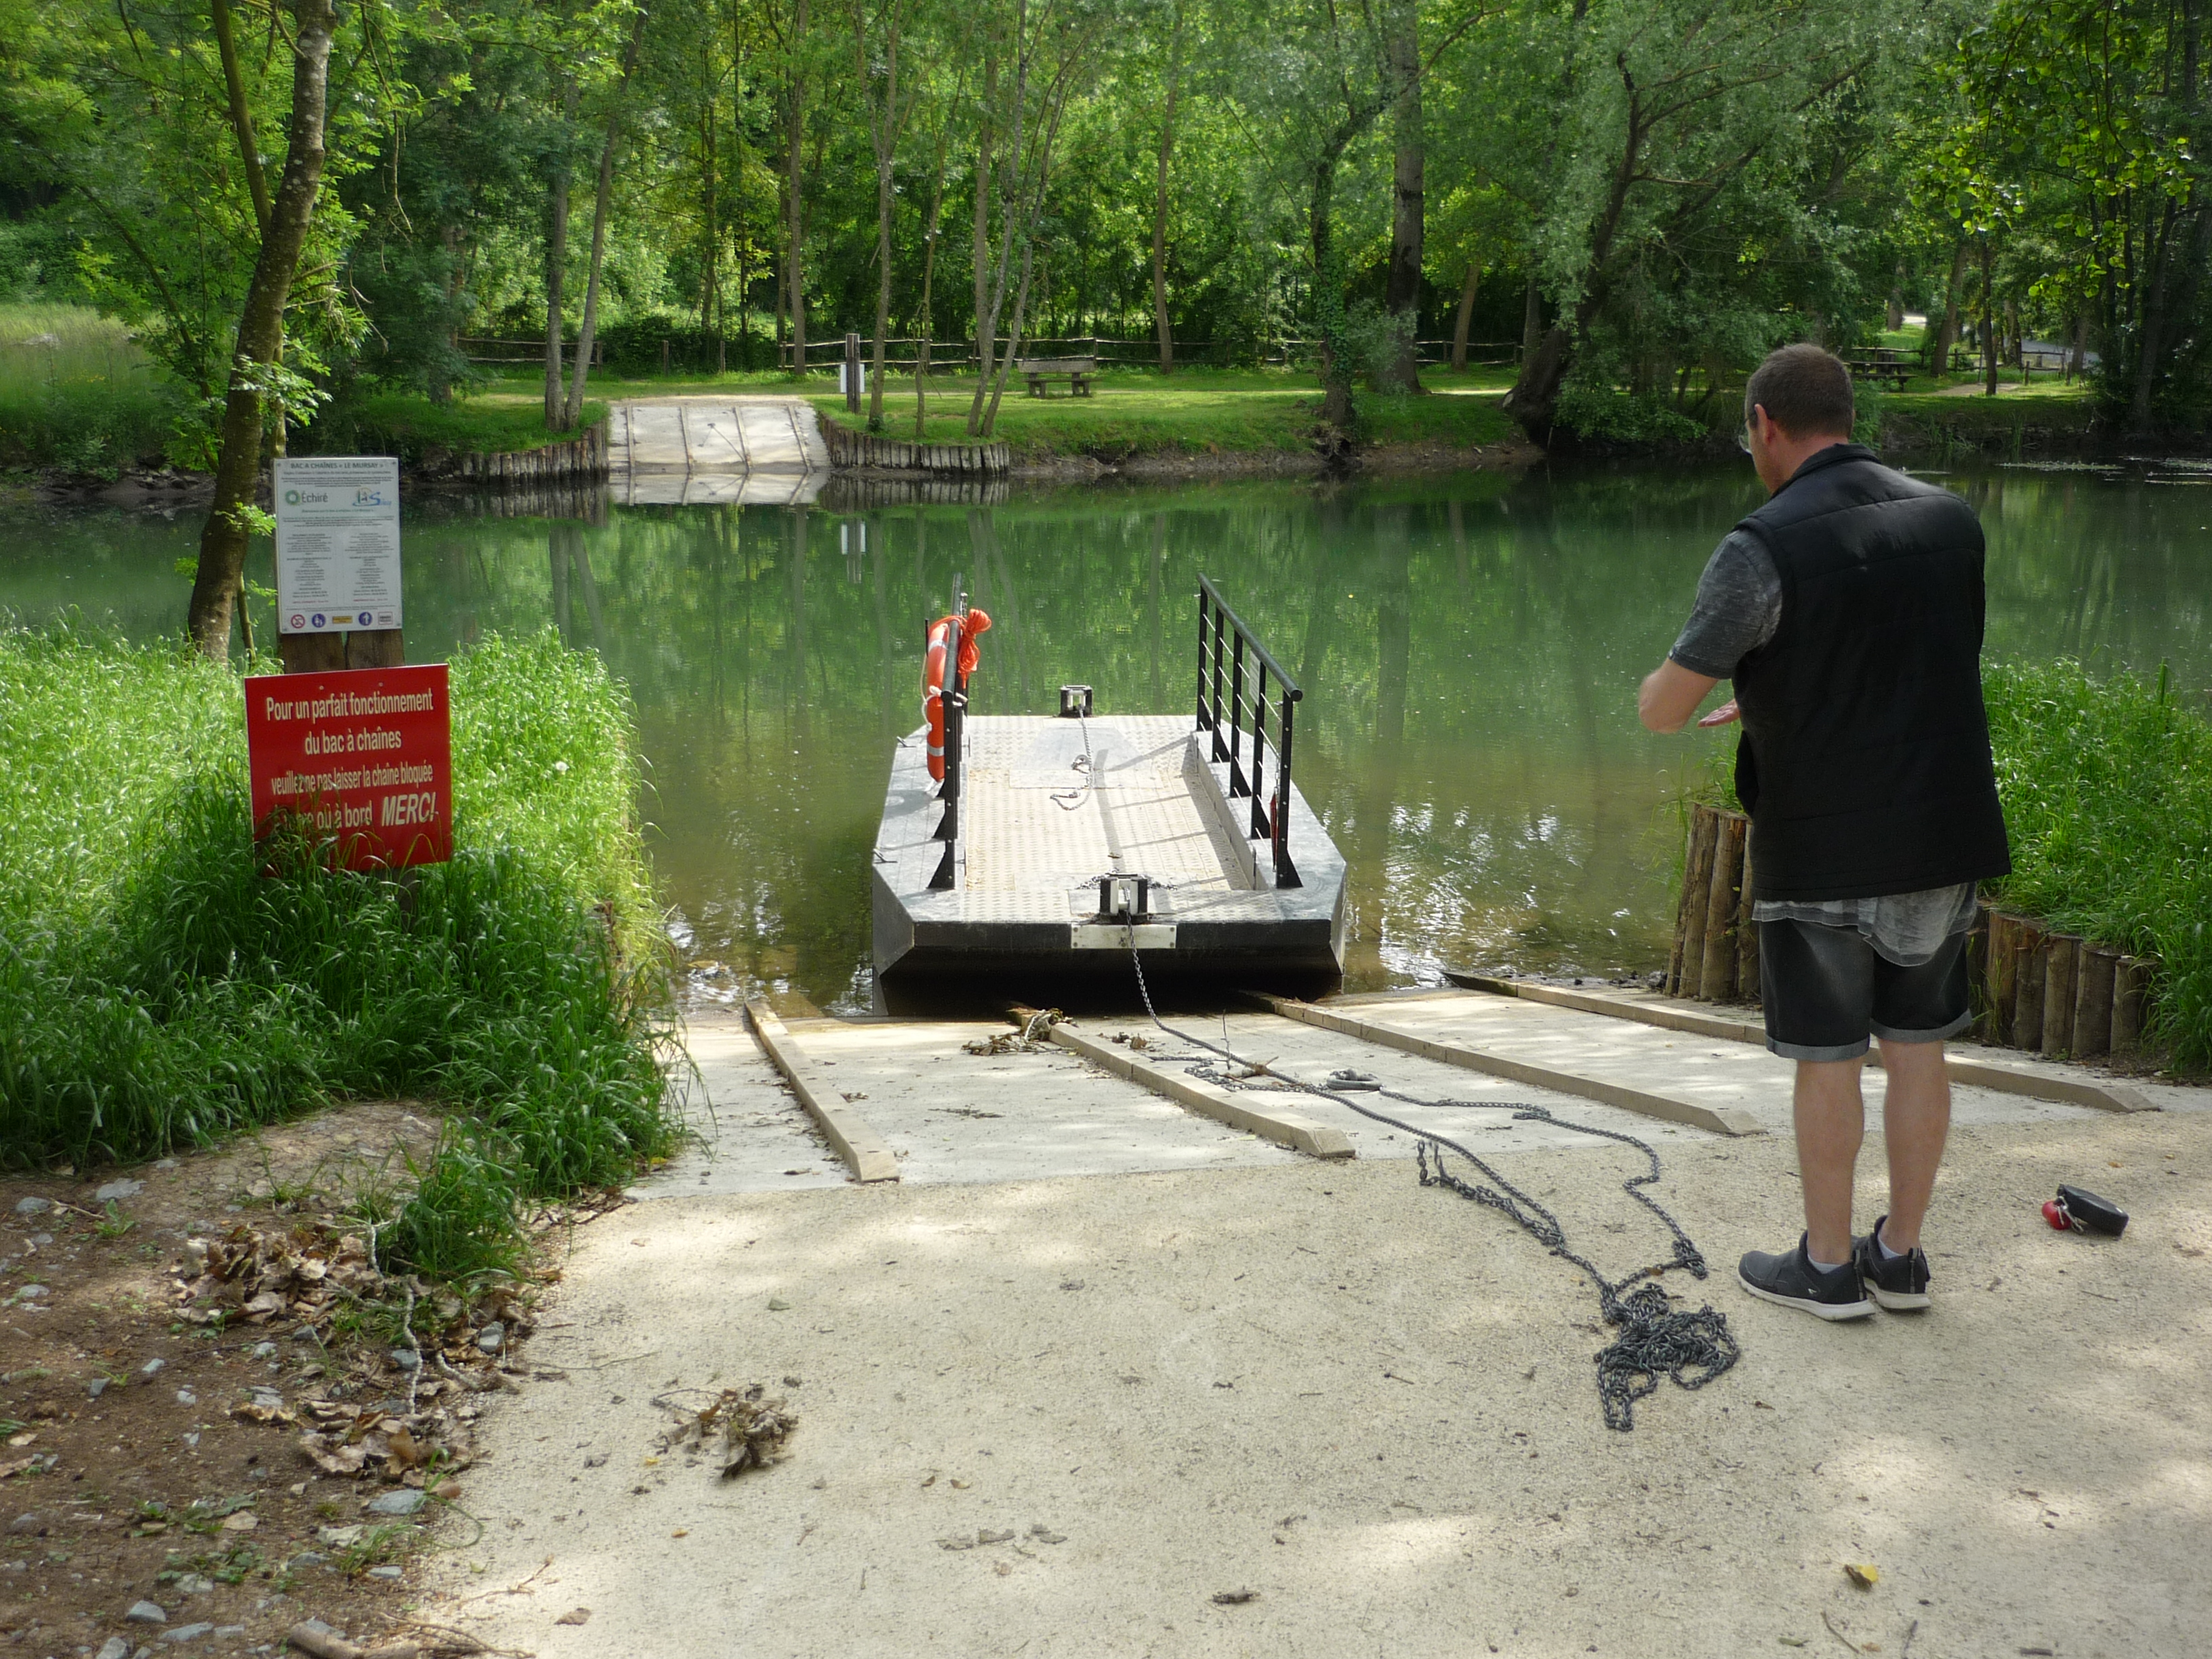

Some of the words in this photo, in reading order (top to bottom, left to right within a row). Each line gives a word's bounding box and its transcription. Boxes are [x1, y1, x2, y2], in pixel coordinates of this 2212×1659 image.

[302, 491, 329, 503] Échiré
[266, 697, 293, 721] Pour
[295, 701, 310, 719] un
[312, 693, 349, 724] parfait
[349, 688, 434, 716] fonctionnement
[305, 731, 320, 756] du
[323, 730, 344, 754] bac
[348, 729, 354, 752] à
[357, 726, 402, 751] chaînes
[271, 770, 304, 796] veuillez
[305, 774, 316, 792] ne
[333, 766, 362, 790] laisser
[363, 764, 371, 787] la
[372, 762, 398, 787] chaîne
[400, 759, 433, 789] bloquée
[344, 800, 373, 828] bord
[382, 791, 436, 827] MERCI
